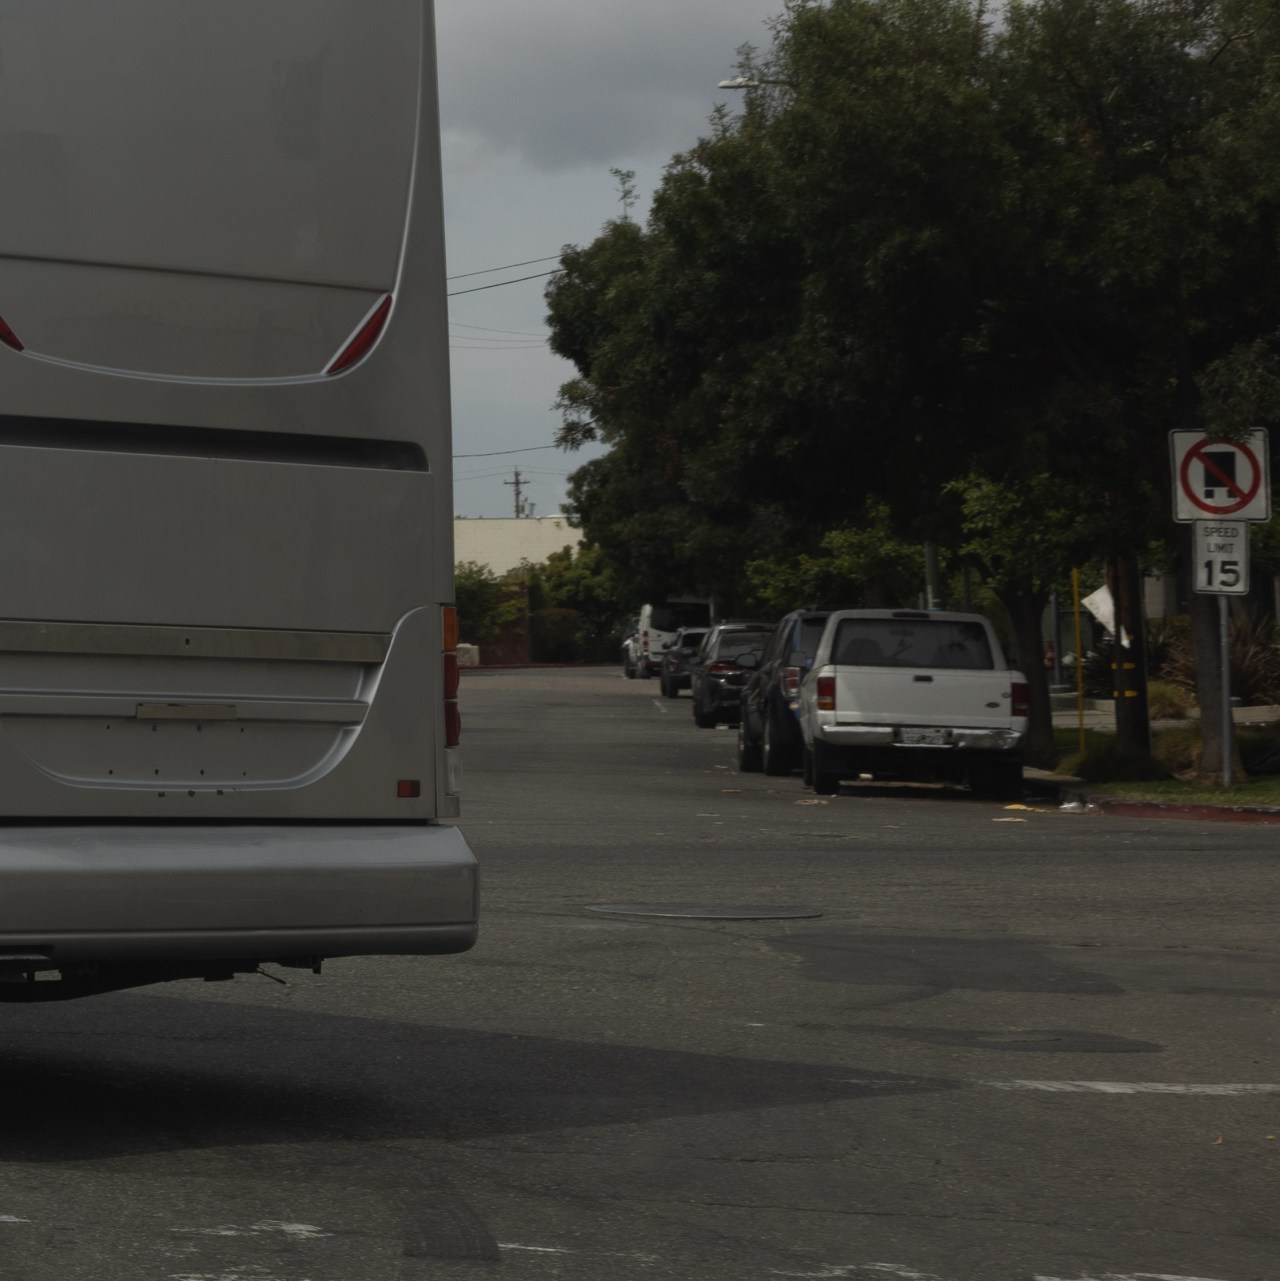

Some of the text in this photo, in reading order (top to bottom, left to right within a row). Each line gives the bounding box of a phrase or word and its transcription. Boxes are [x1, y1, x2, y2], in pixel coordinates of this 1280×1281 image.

[1202, 526, 1240, 538] SPEED
[1206, 542, 1235, 554] LIMIT
[1204, 559, 1241, 588] 15
